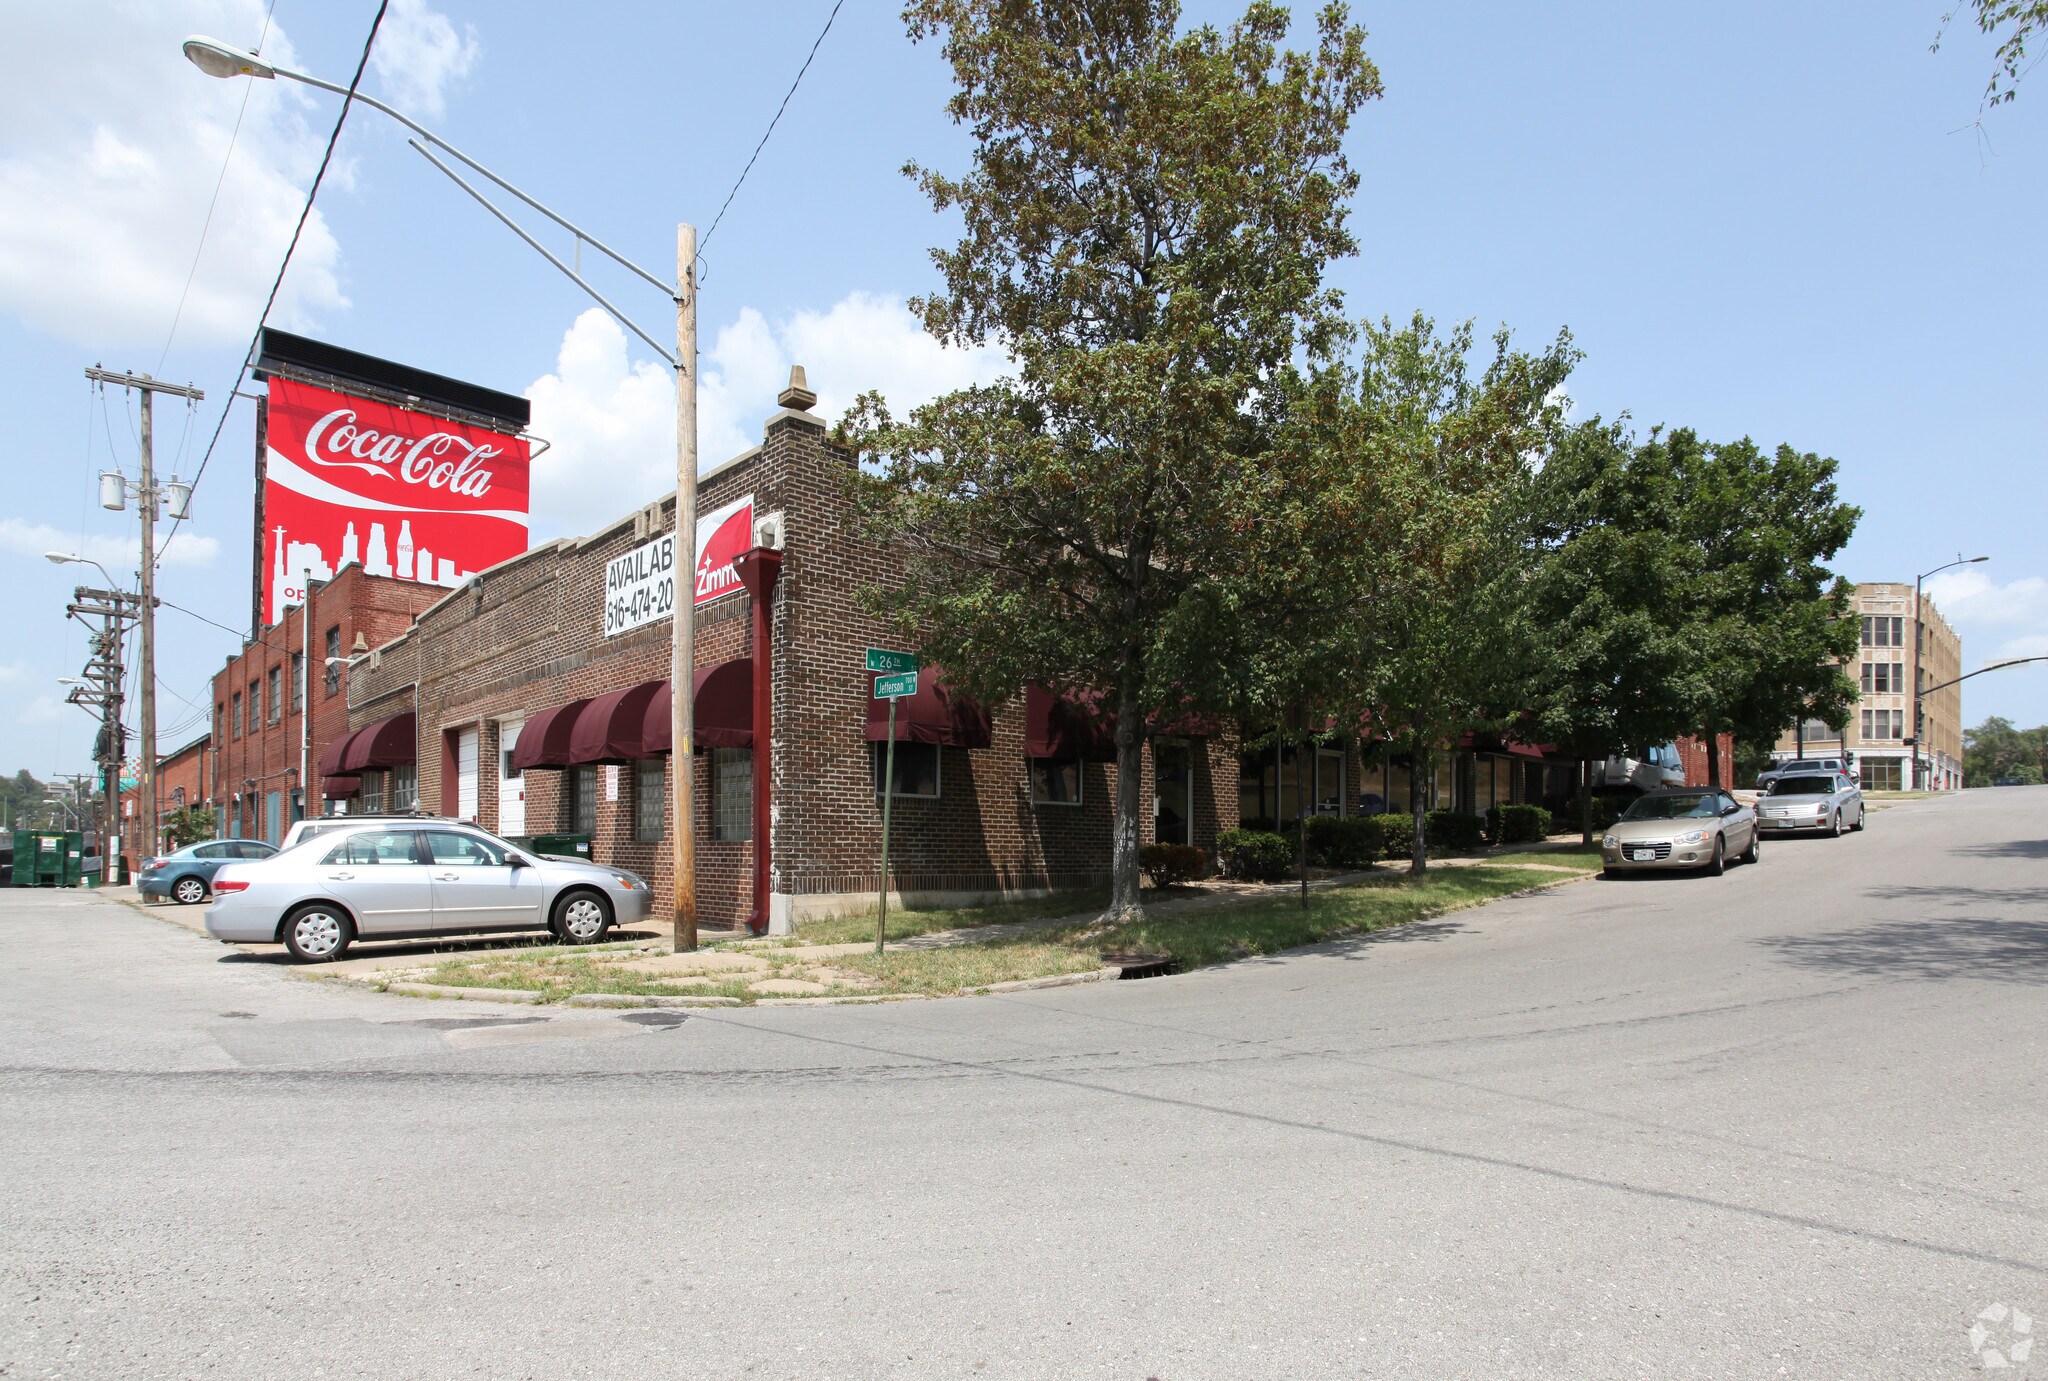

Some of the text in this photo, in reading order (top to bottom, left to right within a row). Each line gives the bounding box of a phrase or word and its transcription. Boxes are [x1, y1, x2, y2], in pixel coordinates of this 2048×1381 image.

[305, 409, 503, 498] Coca-Cola
[608, 535, 676, 594] AVAILAB
[696, 554, 742, 597] Zimm
[607, 577, 674, 631] 816-474-20
[878, 682, 904, 694] Jefferson
